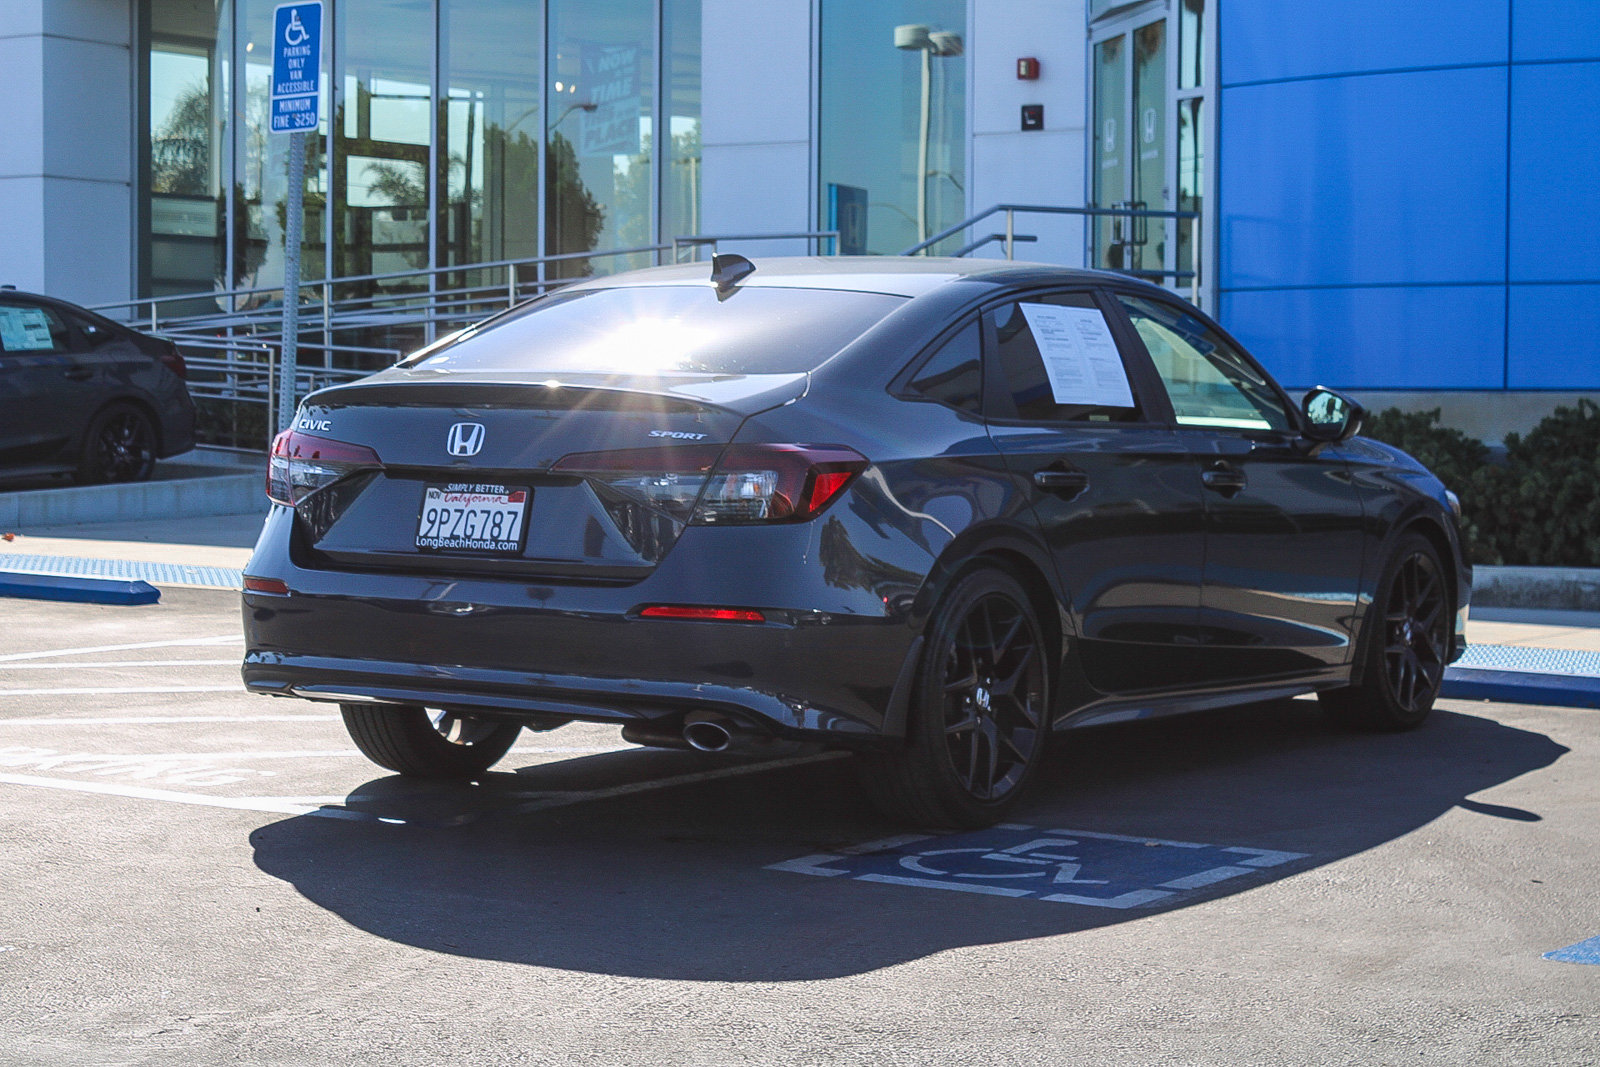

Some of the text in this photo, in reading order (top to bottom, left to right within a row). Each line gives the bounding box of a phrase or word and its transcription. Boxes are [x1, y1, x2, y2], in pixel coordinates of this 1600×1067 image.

[283, 45, 311, 58] PARKING
[288, 57, 305, 69] ONLY
[289, 69, 303, 81] VAN
[277, 80, 315, 94] ACCESSIBLE
[279, 98, 311, 113] MINIMUM
[273, 112, 316, 129] FINE $250
[299, 418, 332, 432] CIVIC
[648, 430, 708, 440] SPORT
[447, 483, 504, 493] SIMPLY BETTER
[428, 491, 508, 506] NOV California
[424, 508, 519, 541] 9PZG787
[416, 536, 518, 551] LongBeachHonda.com
